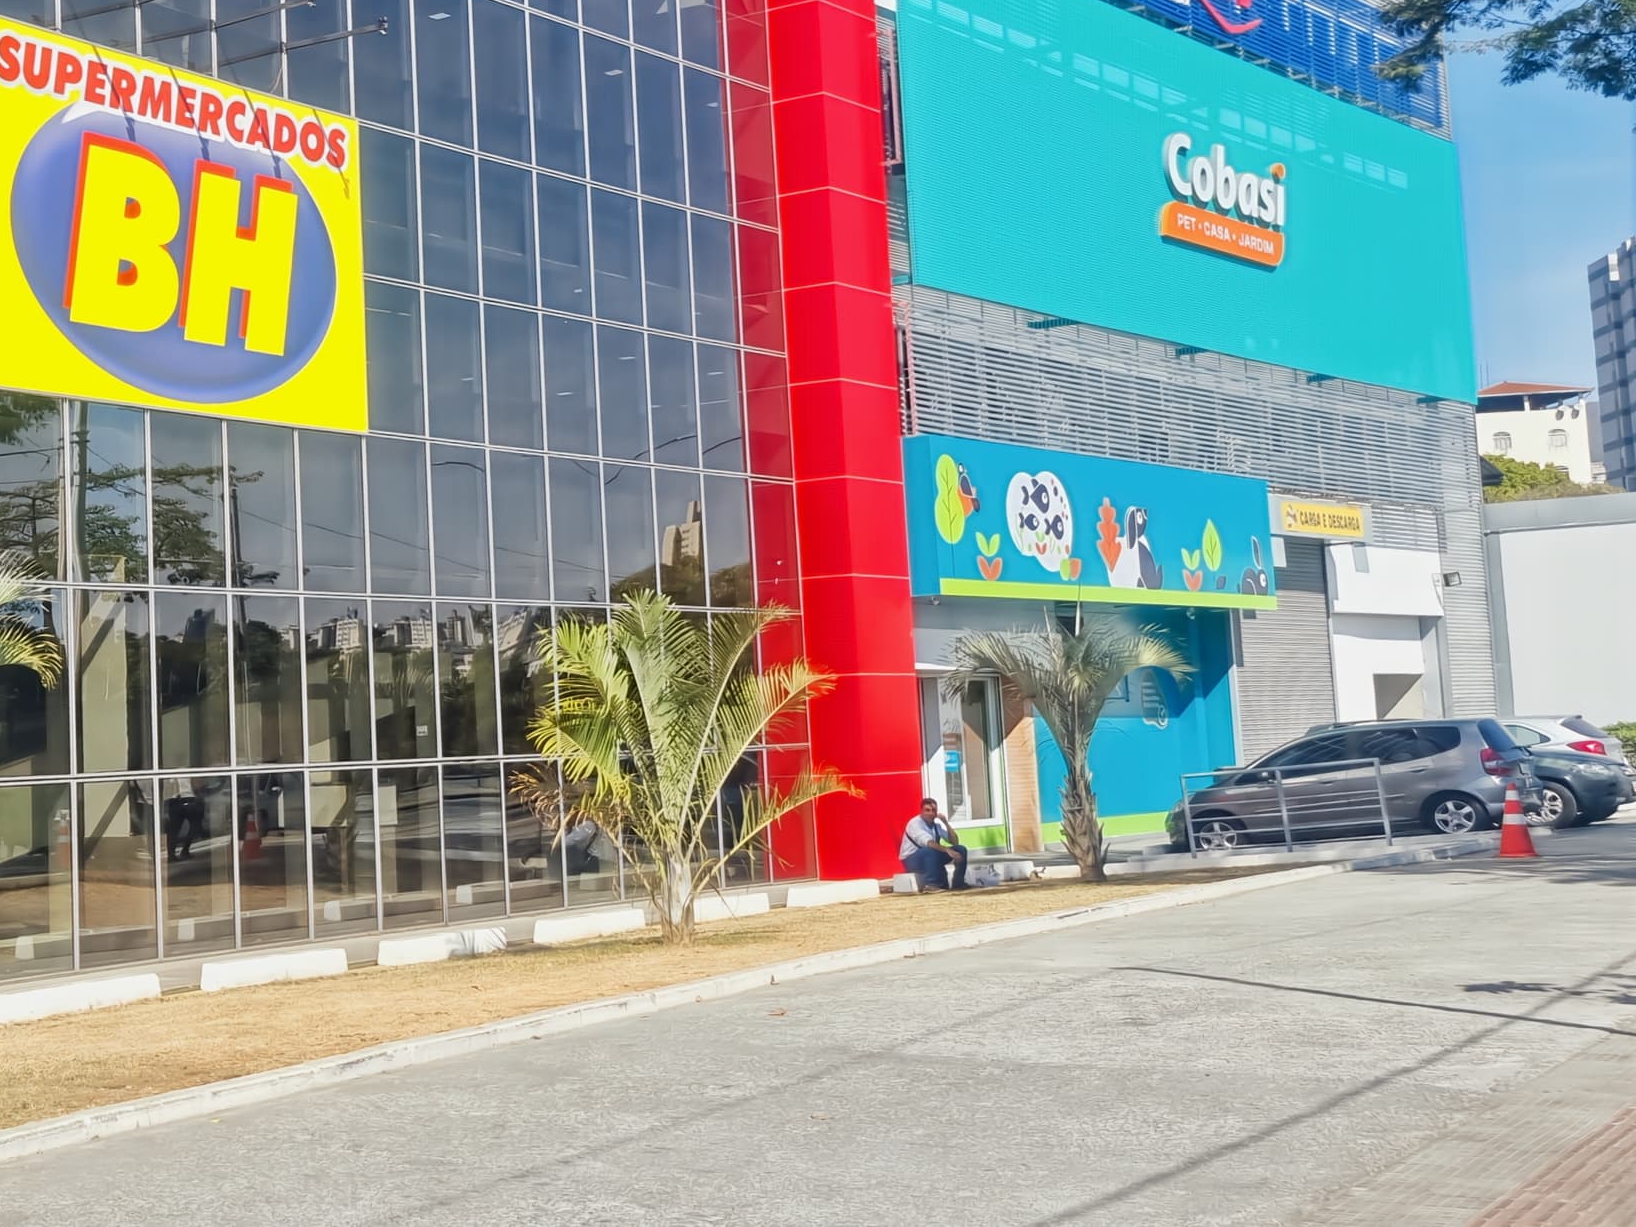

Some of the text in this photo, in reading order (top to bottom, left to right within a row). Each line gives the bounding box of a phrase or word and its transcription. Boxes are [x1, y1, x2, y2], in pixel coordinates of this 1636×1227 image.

[1163, 132, 1285, 227] Cobasi
[64, 131, 298, 356] BH
[1176, 212, 1275, 255] PET CASA JARDIM
